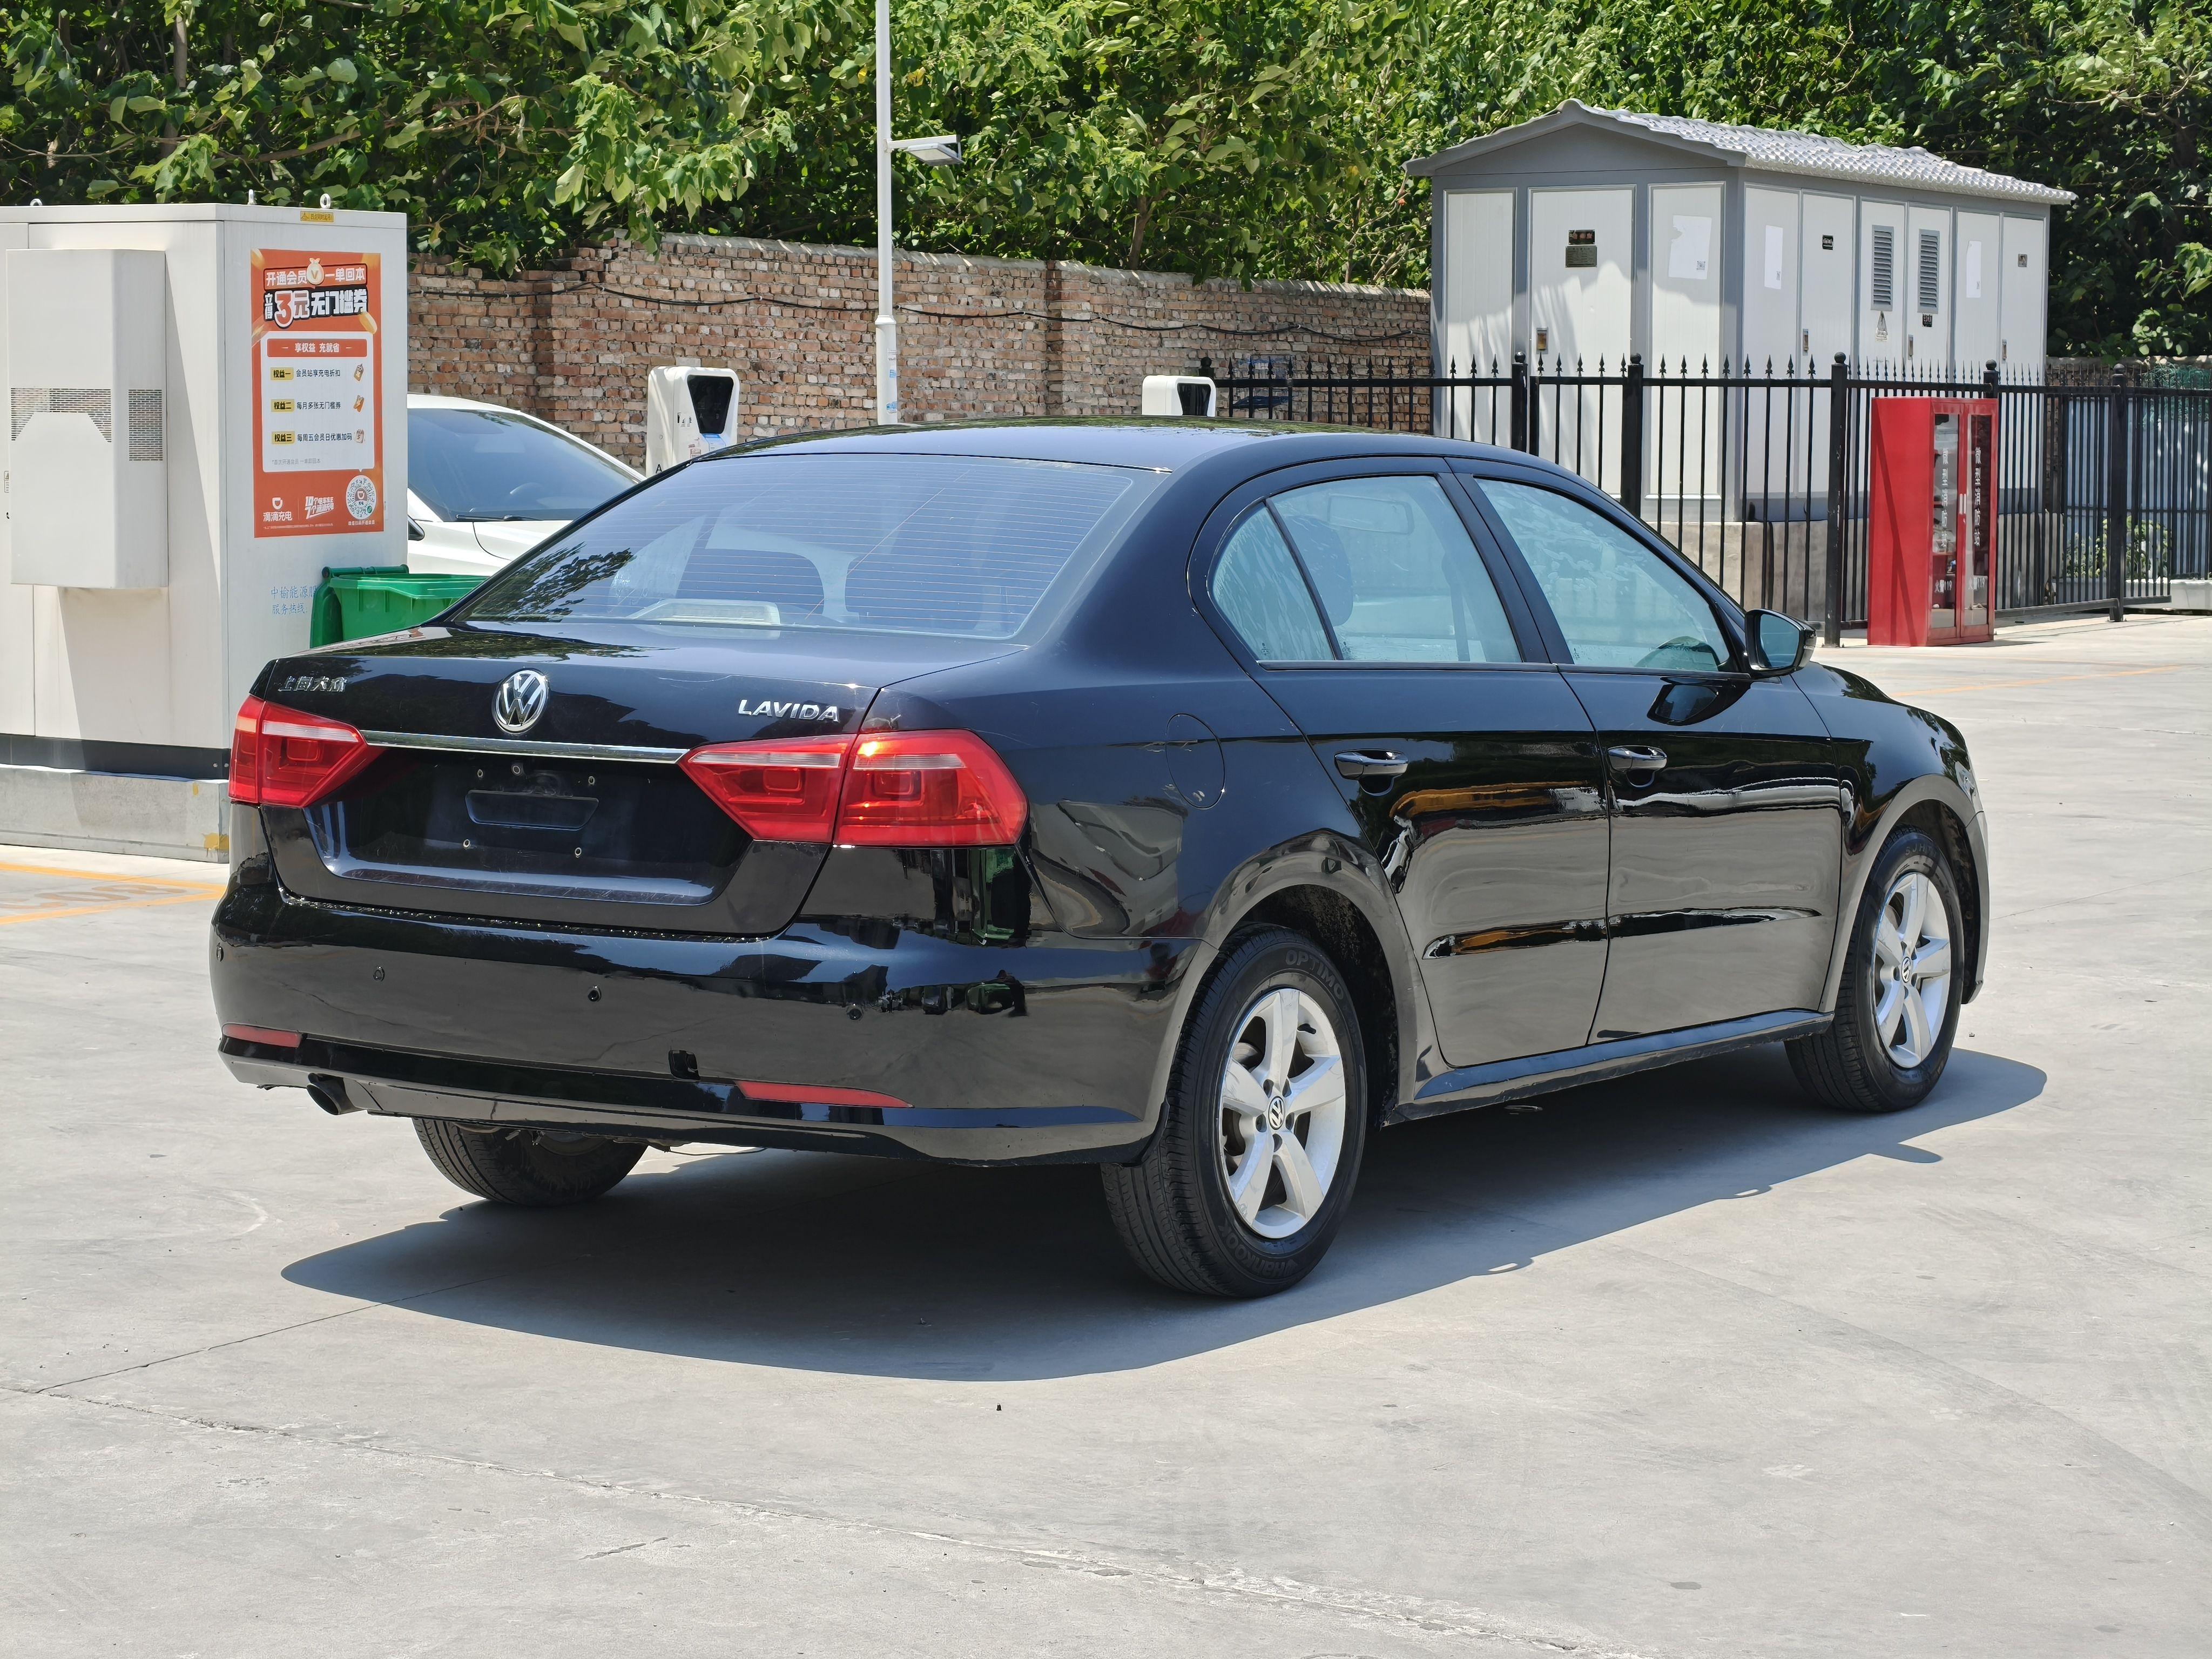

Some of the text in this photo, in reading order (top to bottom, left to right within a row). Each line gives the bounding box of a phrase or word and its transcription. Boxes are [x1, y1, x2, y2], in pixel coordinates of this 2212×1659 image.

[266, 269, 307, 286] 开通会员
[325, 267, 366, 282] 一单回本
[294, 342, 340, 353] 享权益 充就省
[273, 369, 341, 378] 权益一 会员站享充电折扣
[274, 401, 341, 410] 权益二 每月多张无门槛券
[274, 433, 353, 442] 权益三 每周五会员日优惠加码
[263, 511, 293, 522] 滴滴充电
[738, 699, 839, 722] LAVIDA
[1285, 949, 1344, 1000] OPTIMO
